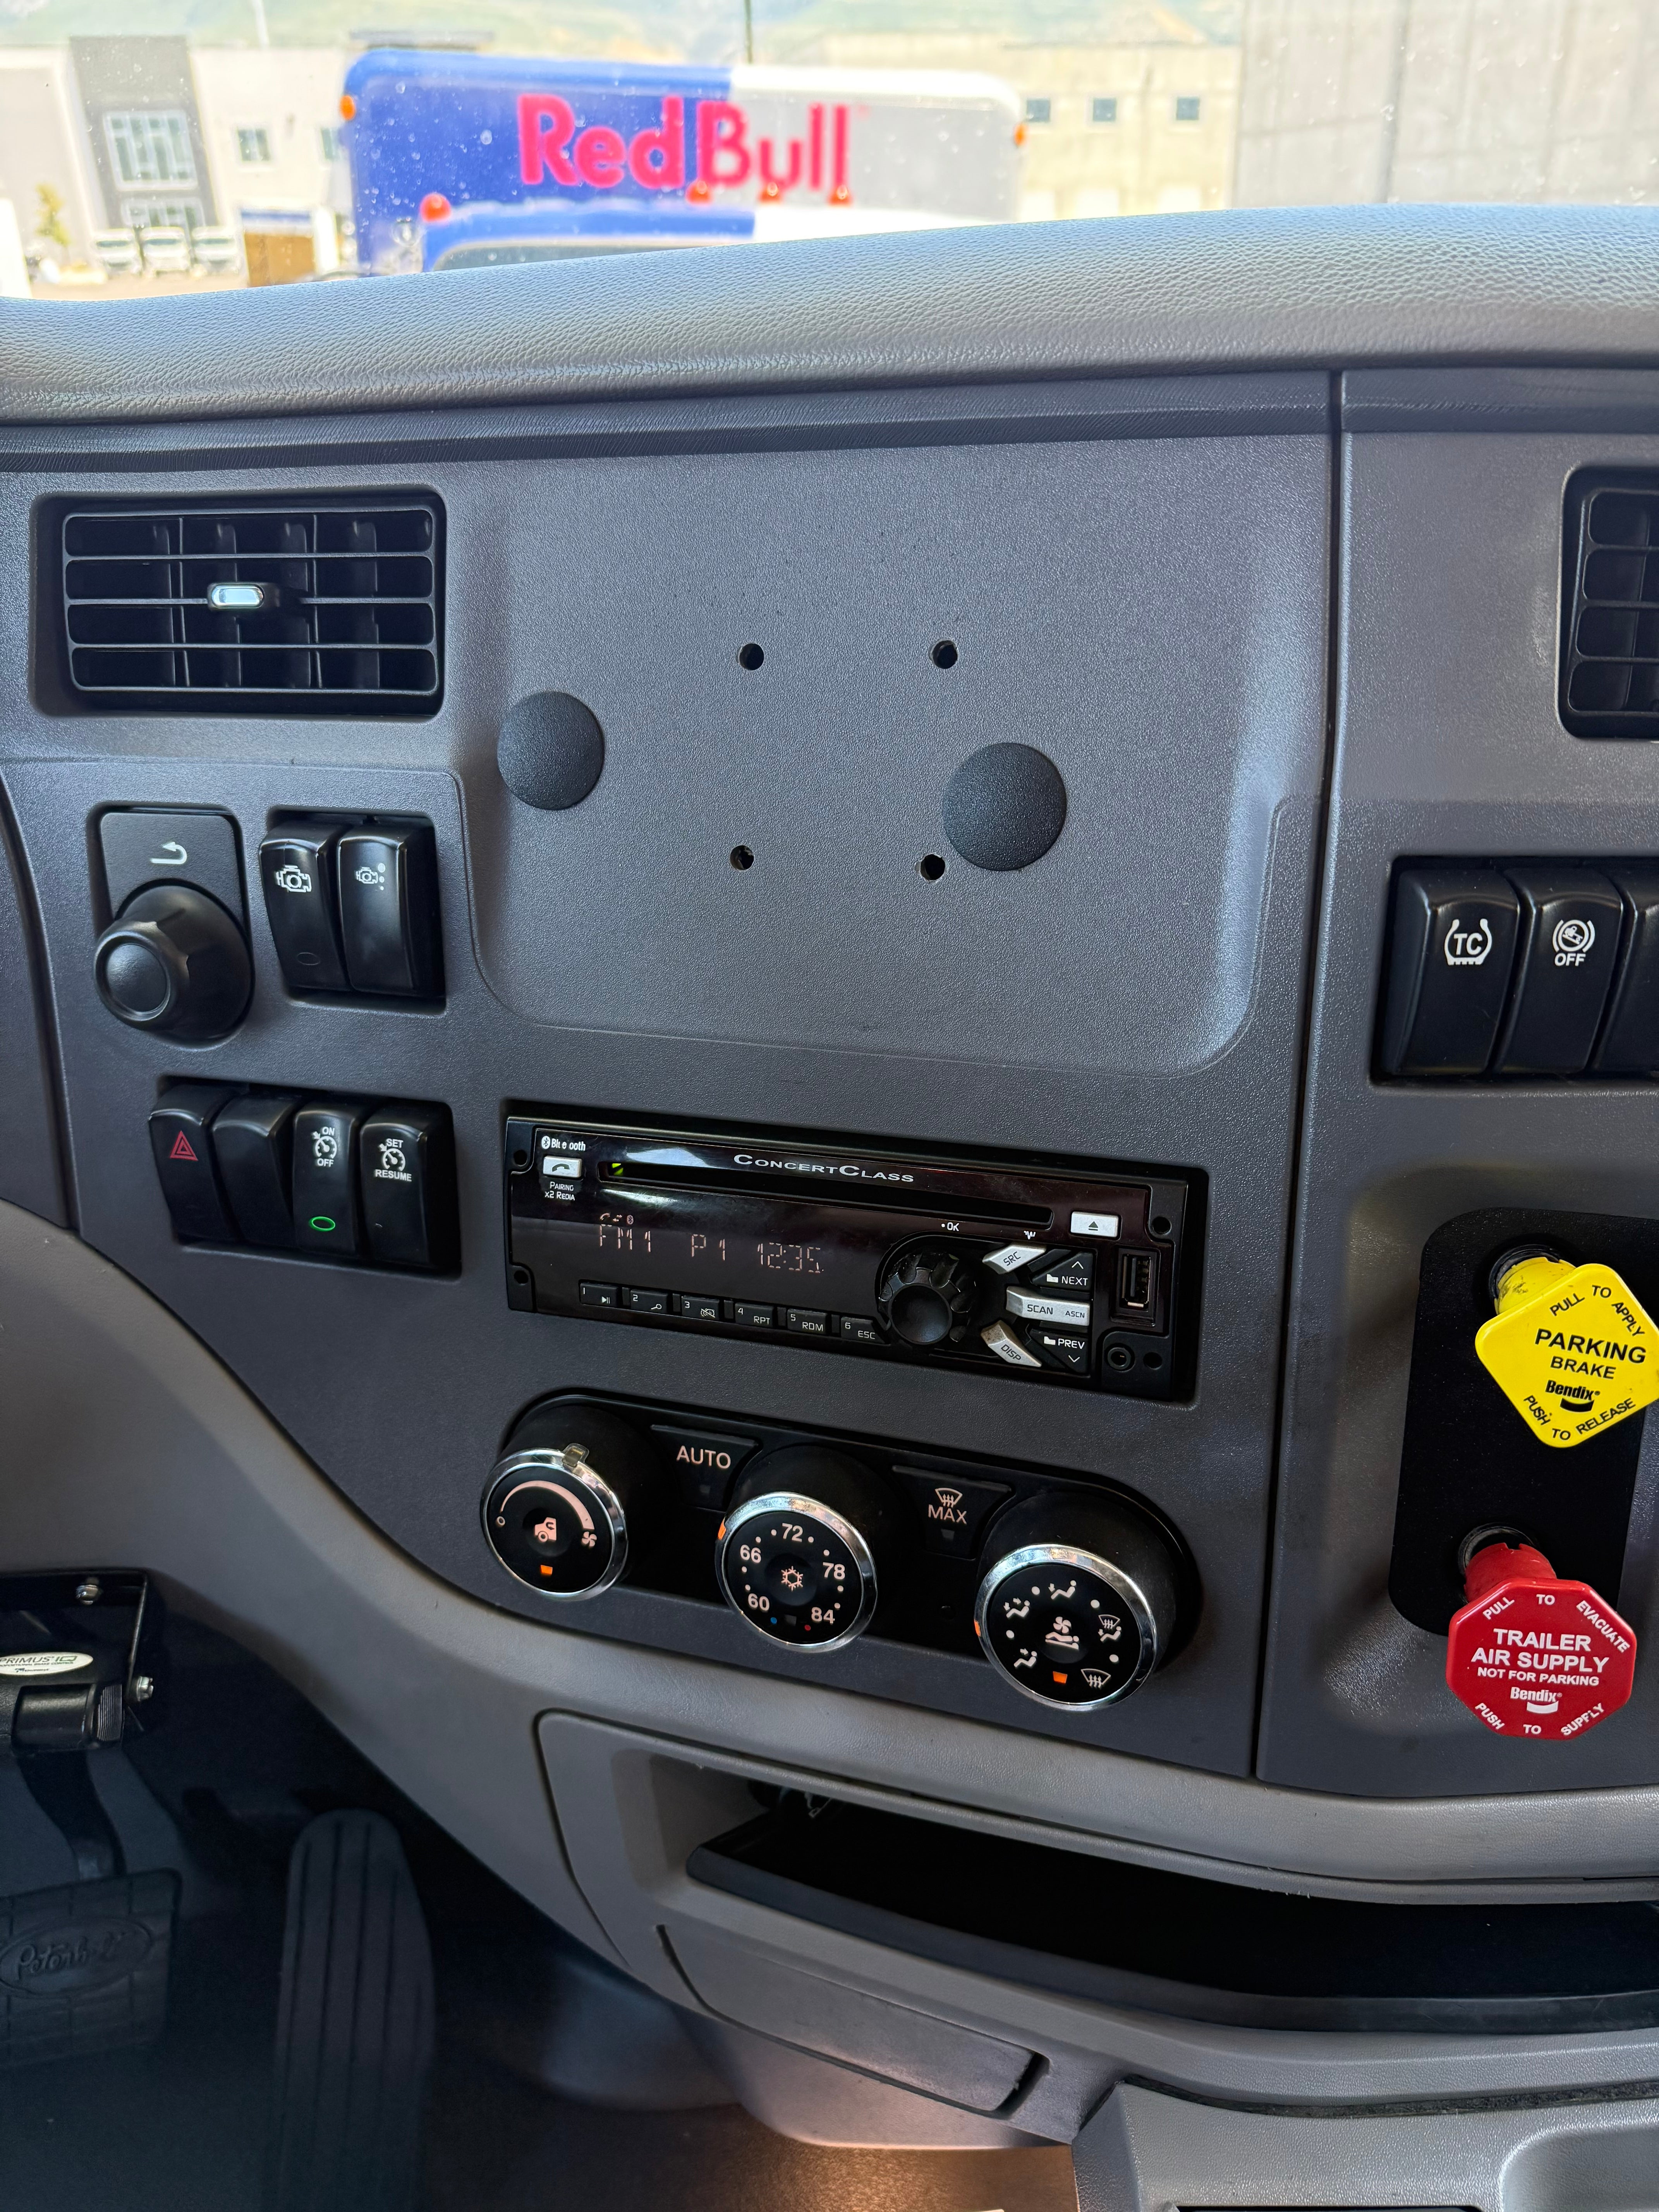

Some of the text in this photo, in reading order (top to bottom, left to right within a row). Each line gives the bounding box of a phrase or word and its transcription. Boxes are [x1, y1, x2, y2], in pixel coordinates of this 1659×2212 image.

[518, 93, 849, 192] Red Bull
[1453, 933, 1483, 955] TC
[1554, 953, 1586, 966] OFF
[322, 1126, 335, 1136] ON
[386, 1138, 404, 1148] SET
[317, 1158, 334, 1167] OFF
[374, 1169, 412, 1182] RESUME
[1003, 1251, 1022, 1266] SRC
[1061, 1276, 1089, 1286] NEXT
[1027, 1304, 1053, 1315] SCAN
[1549, 1285, 1645, 1337] PULL TO APPLY
[754, 1316, 771, 1325] RPT
[802, 1321, 824, 1332] RDM
[857, 1330, 876, 1340] ESC
[1058, 1338, 1085, 1350] PREV
[1000, 1344, 1022, 1360] DISP
[1535, 1328, 1647, 1364] PARKING
[1550, 1356, 1617, 1379] BRAKE
[1523, 1395, 1637, 1441] PUSH TO RELEASE
[676, 1445, 732, 1469] AUTO
[928, 1504, 967, 1525] MAX
[782, 1523, 803, 1542] 72
[740, 1544, 762, 1564] 66
[823, 1561, 845, 1580] 78
[747, 1593, 770, 1611] 60
[811, 1606, 835, 1624] 84
[1482, 1594, 1630, 1653] PULL TO EVACUATE
[1493, 1628, 1591, 1652] TRAILER
[1471, 1647, 1609, 1673] AIR SUPPLY
[1477, 1667, 1600, 1686] NOT FOR PARKING
[1475, 1702, 1604, 1736] PUSH TO SUPPLY
